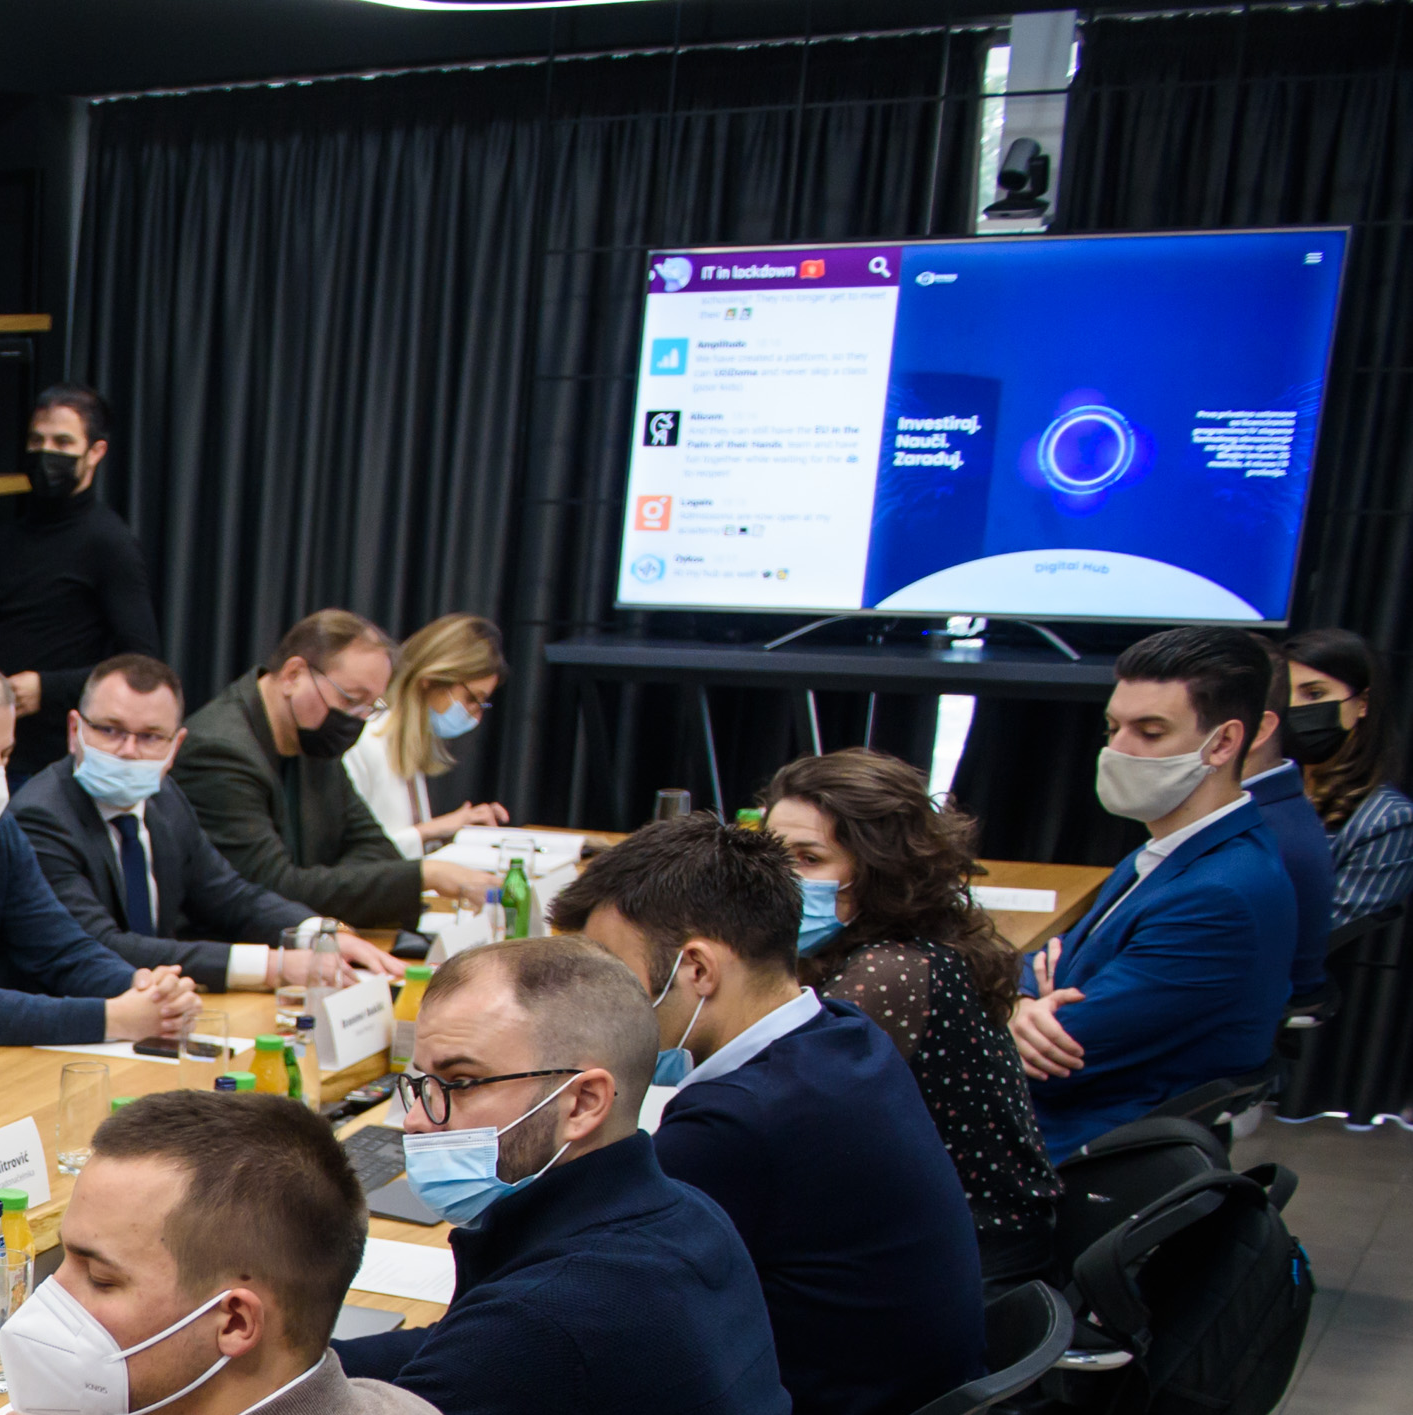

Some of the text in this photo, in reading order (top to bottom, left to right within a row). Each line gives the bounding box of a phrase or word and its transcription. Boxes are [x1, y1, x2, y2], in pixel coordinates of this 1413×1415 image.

[700, 263, 796, 281] IT in lockdown
[697, 340, 748, 350] Amplitude
[897, 414, 983, 435] Investiraj.
[895, 432, 952, 449] Nauči.
[1034, 559, 1111, 575] Digital Hub
